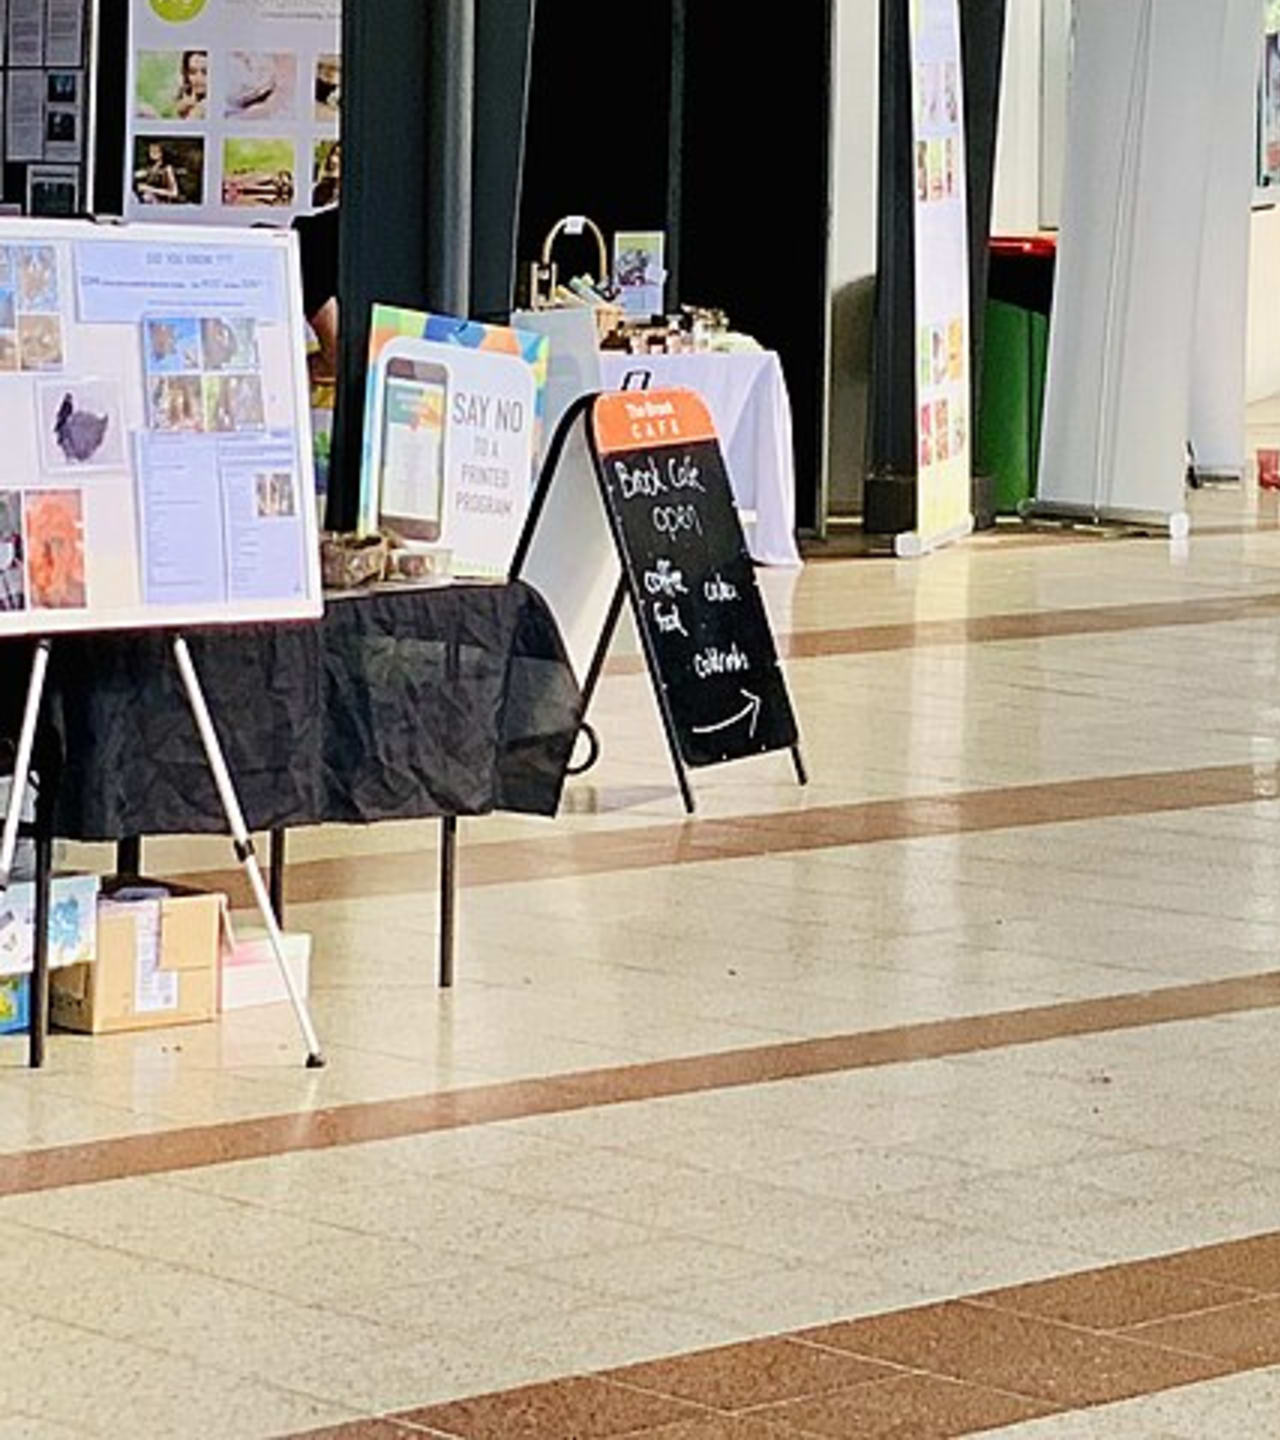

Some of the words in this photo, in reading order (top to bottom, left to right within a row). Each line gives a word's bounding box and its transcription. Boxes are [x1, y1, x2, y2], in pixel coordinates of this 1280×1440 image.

[452, 392, 490, 428] SAY
[495, 399, 523, 433] NO
[474, 435, 488, 456] TO
[491, 441, 499, 458] A
[461, 463, 510, 489] PRINTED
[455, 491, 514, 519] PROGRAM
[652, 504, 704, 541] open
